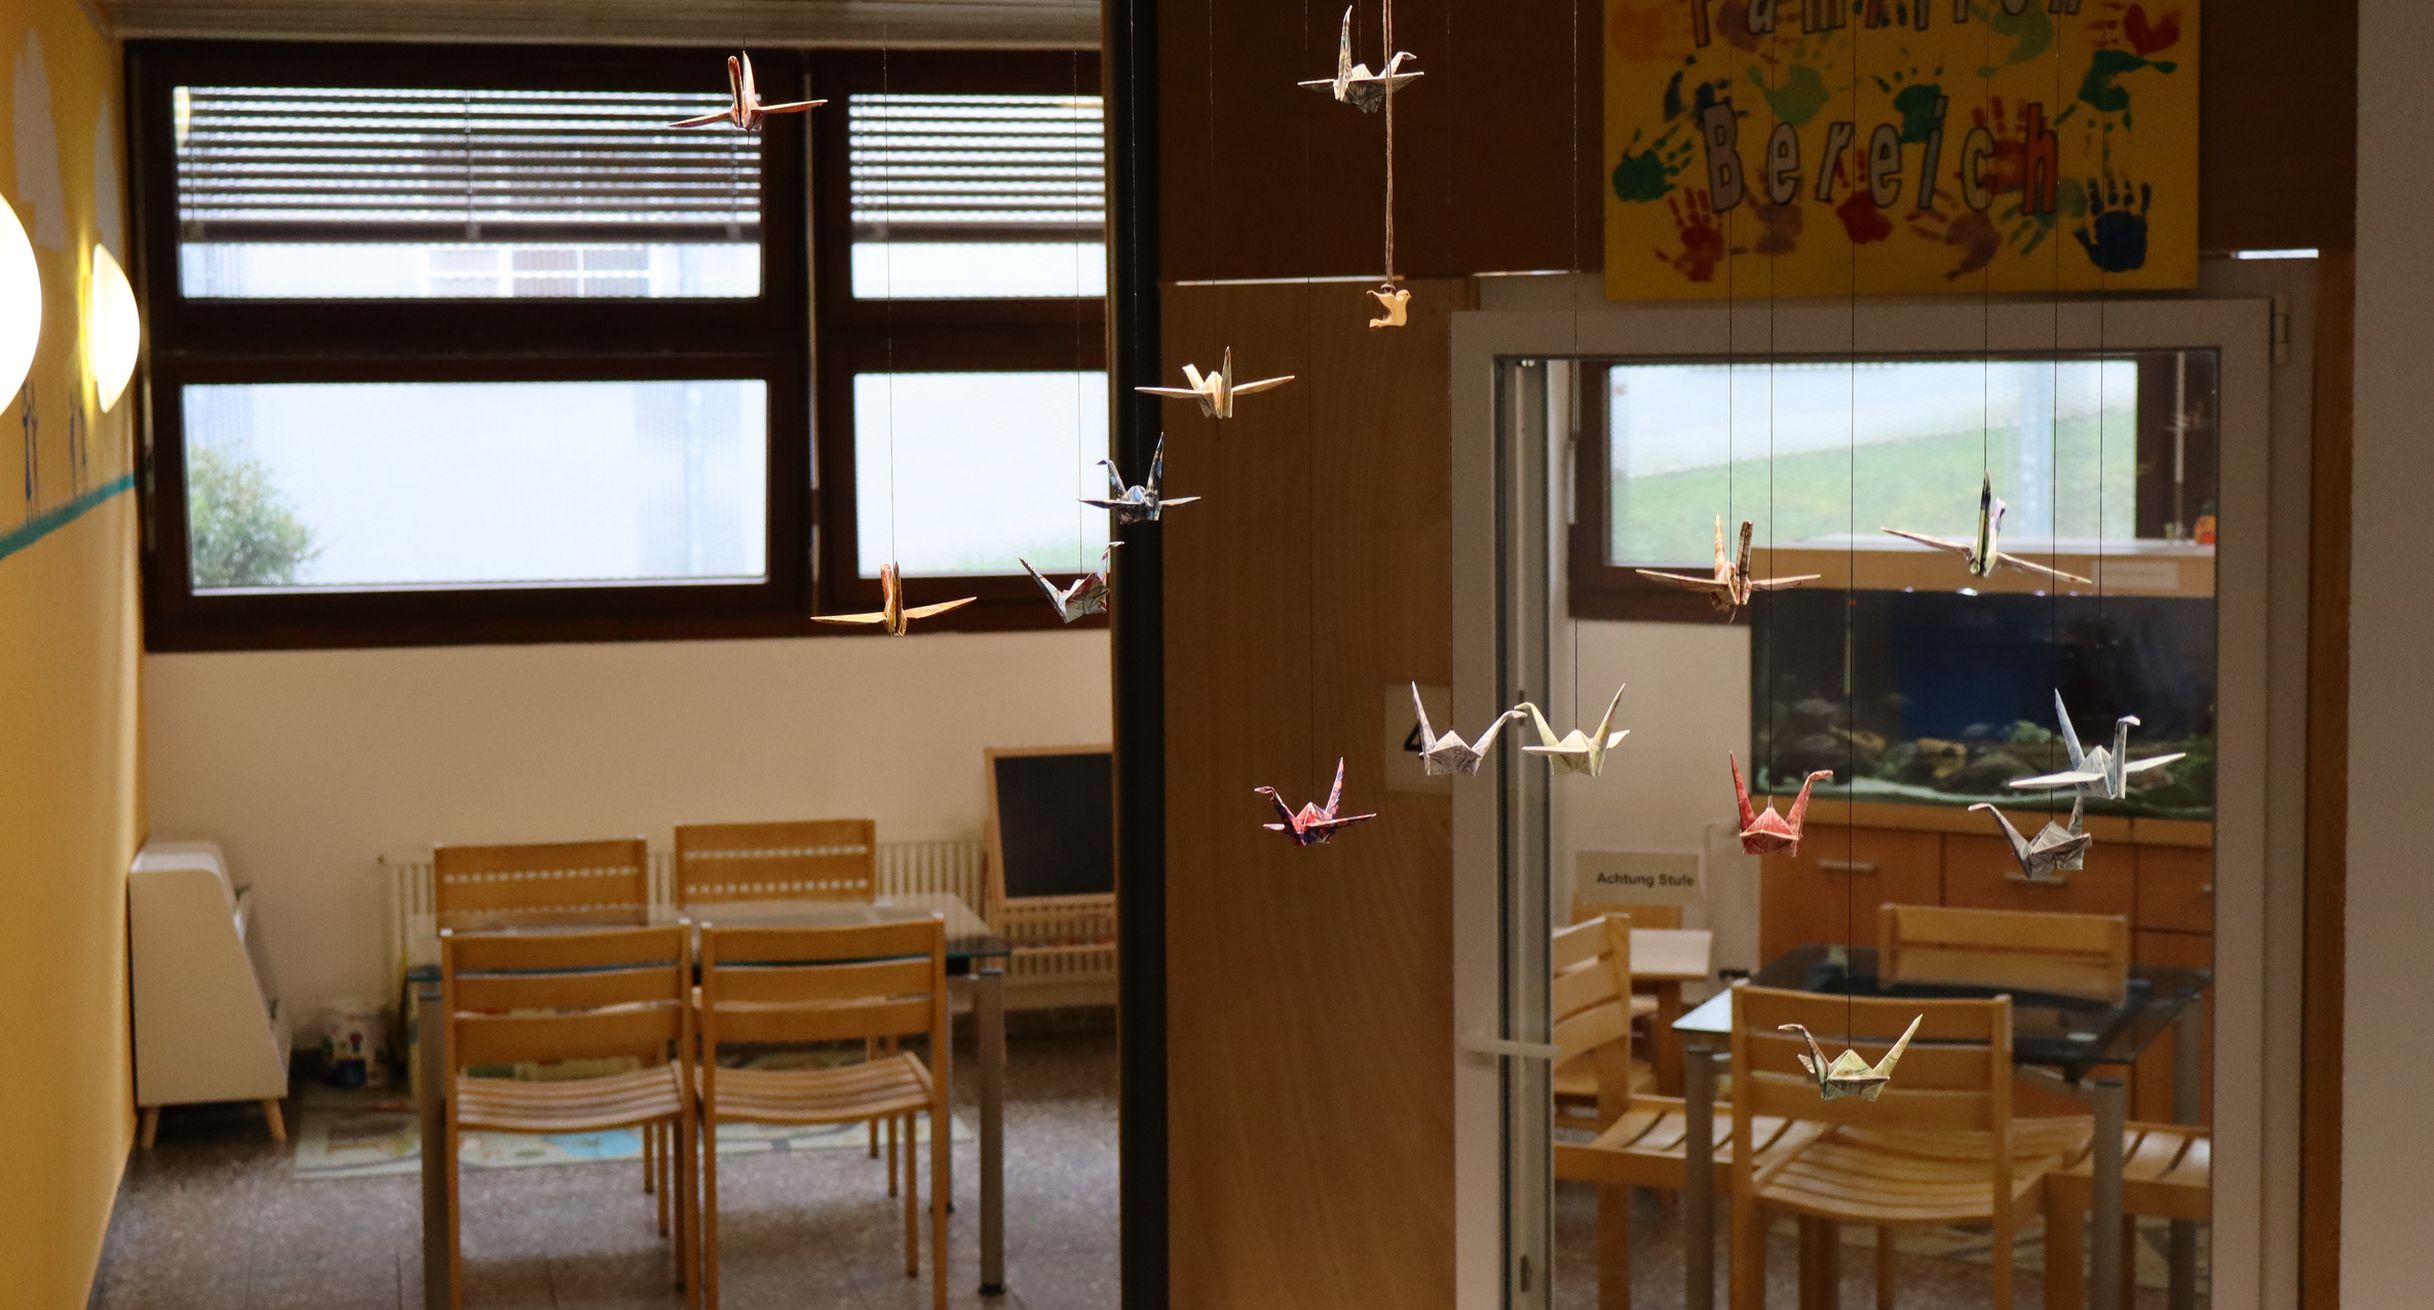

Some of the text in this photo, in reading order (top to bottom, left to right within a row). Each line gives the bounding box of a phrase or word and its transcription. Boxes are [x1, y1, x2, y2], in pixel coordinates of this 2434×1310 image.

[1702, 95, 2058, 216] Bereich
[1596, 872, 1695, 888] Achtung Stufe
